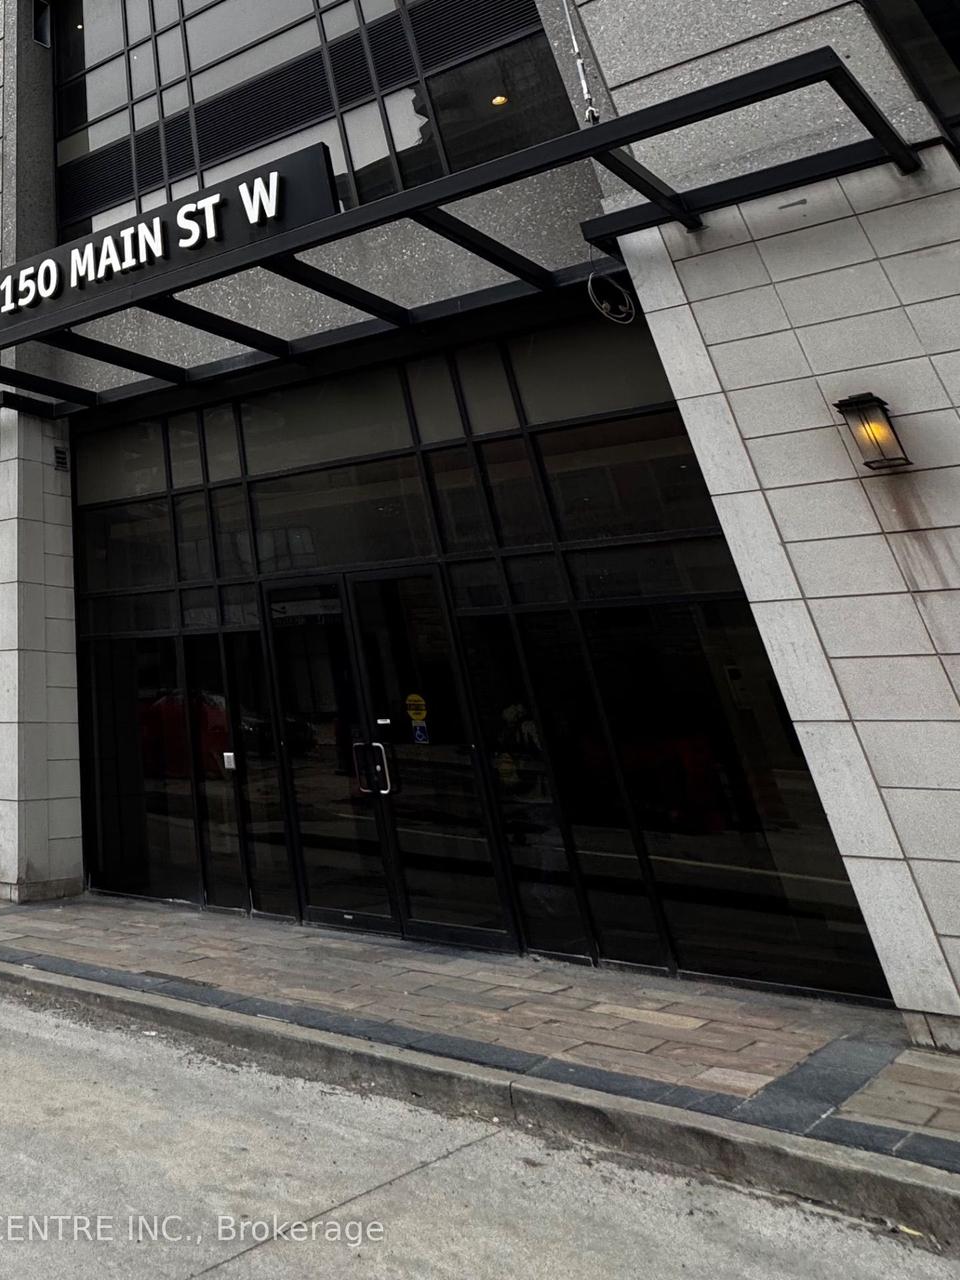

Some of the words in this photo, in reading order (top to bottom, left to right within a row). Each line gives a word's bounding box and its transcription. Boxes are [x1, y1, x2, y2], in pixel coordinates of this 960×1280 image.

[69, 216, 164, 288] MAIN
[176, 193, 222, 248] ST
[238, 171, 280, 224] W
